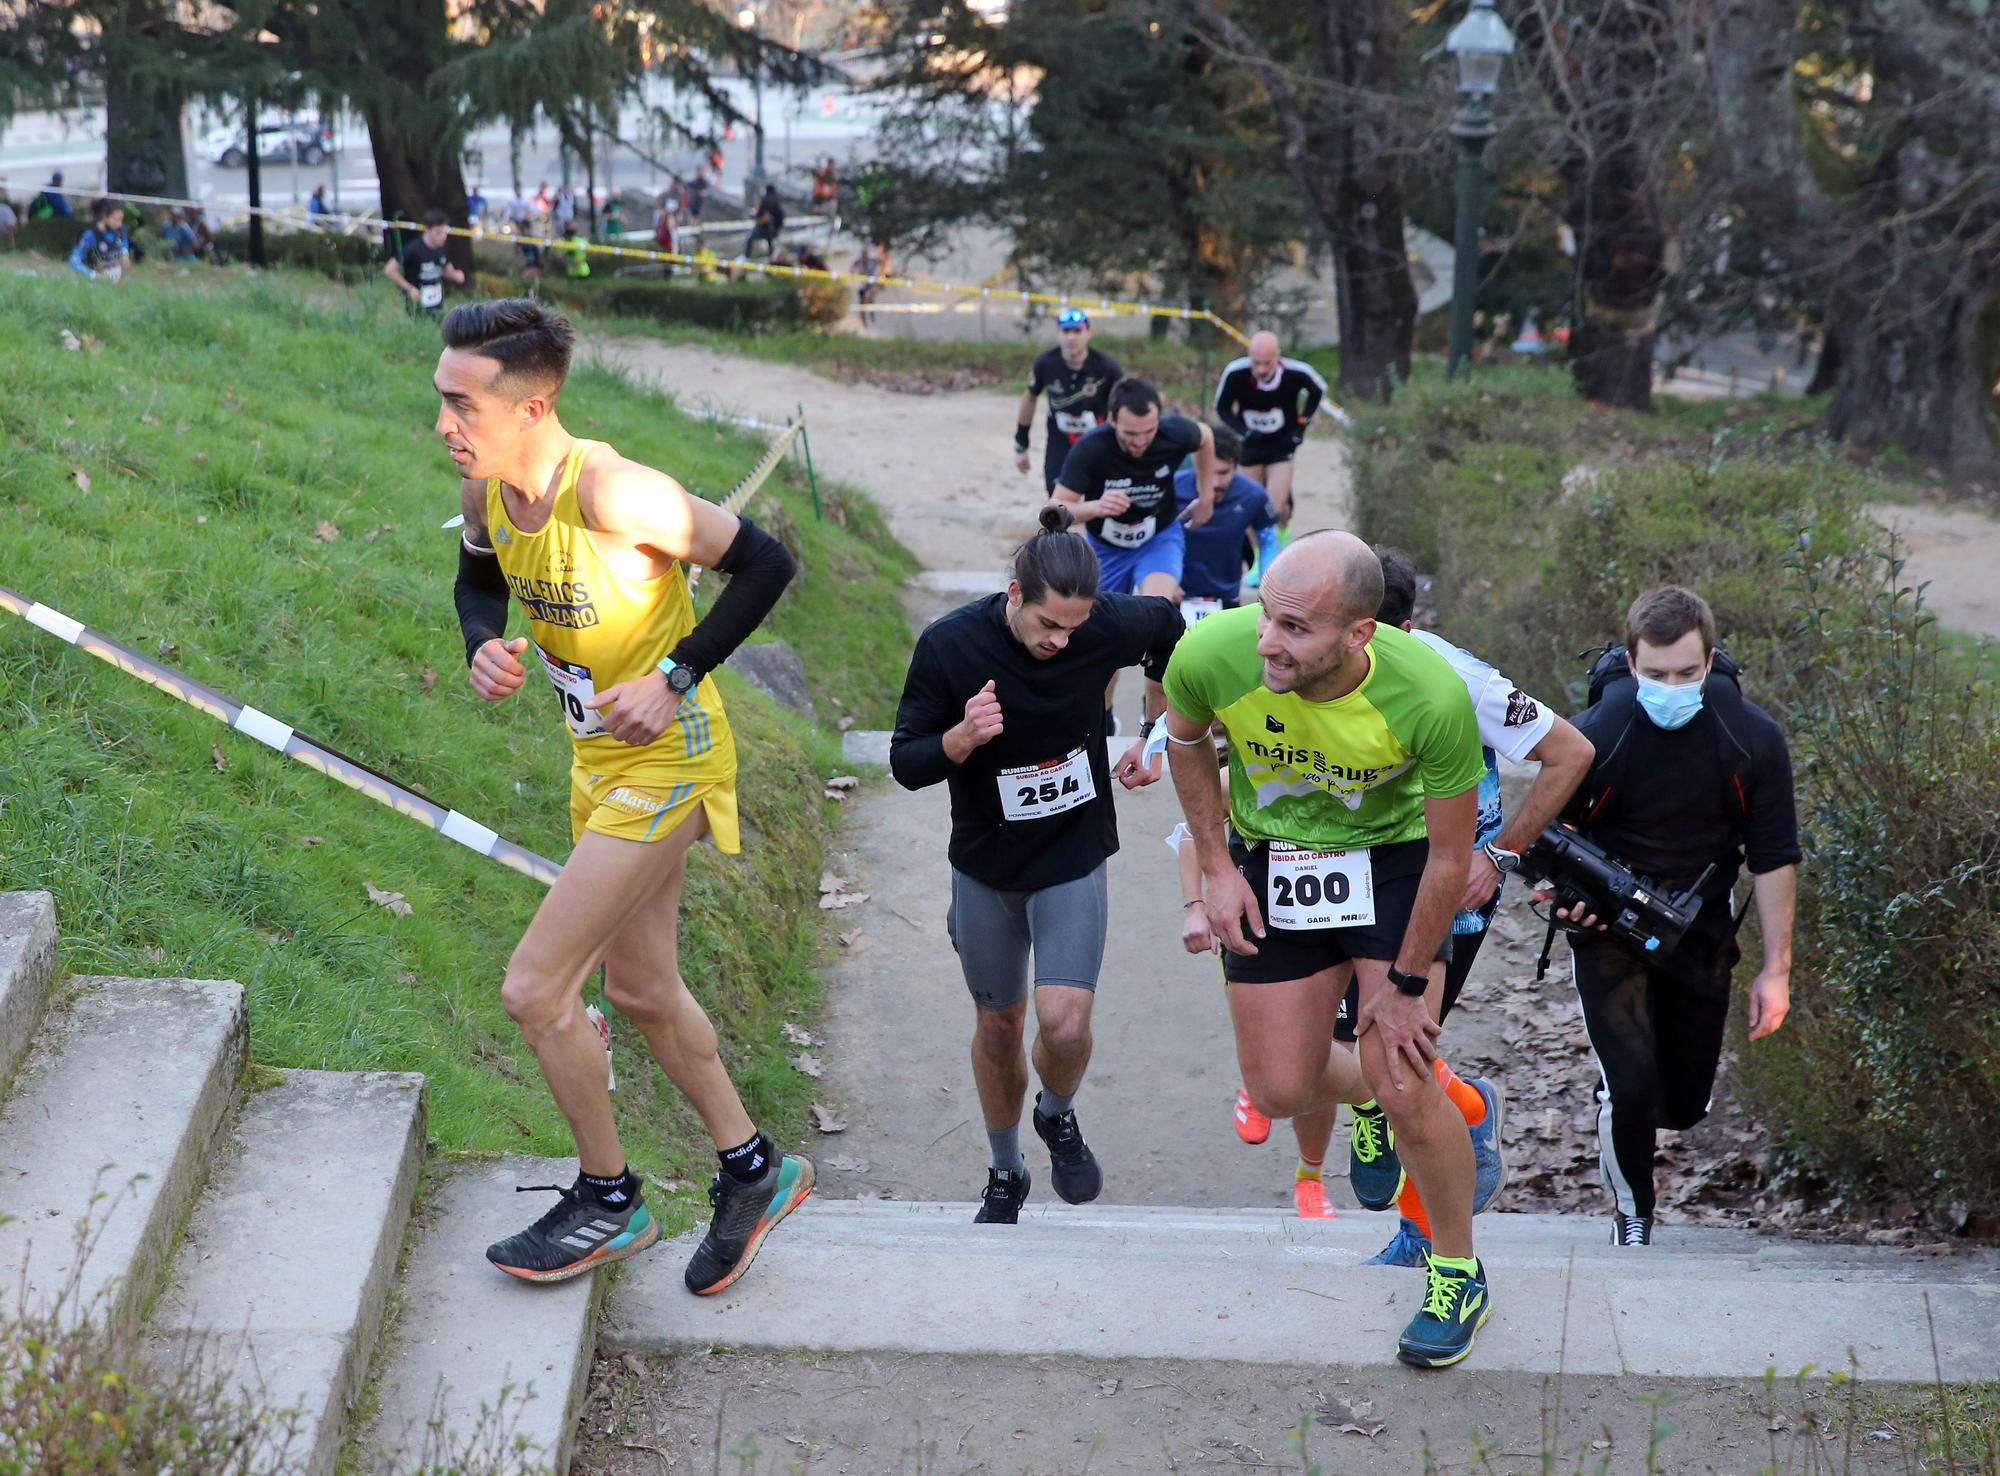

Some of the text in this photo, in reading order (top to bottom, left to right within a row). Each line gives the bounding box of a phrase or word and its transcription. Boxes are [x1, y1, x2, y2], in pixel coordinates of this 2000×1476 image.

[1112, 530, 1146, 541] 250
[1246, 742, 1308, 765] máis
[1040, 769, 1050, 777] AO
[1050, 760, 1074, 774] CASTRO
[1017, 775, 1079, 807] 254
[1298, 853, 1309, 861] AO
[1311, 851, 1346, 859] CASTRO
[1273, 871, 1350, 907] 200
[1307, 916, 1331, 924] GADIS
